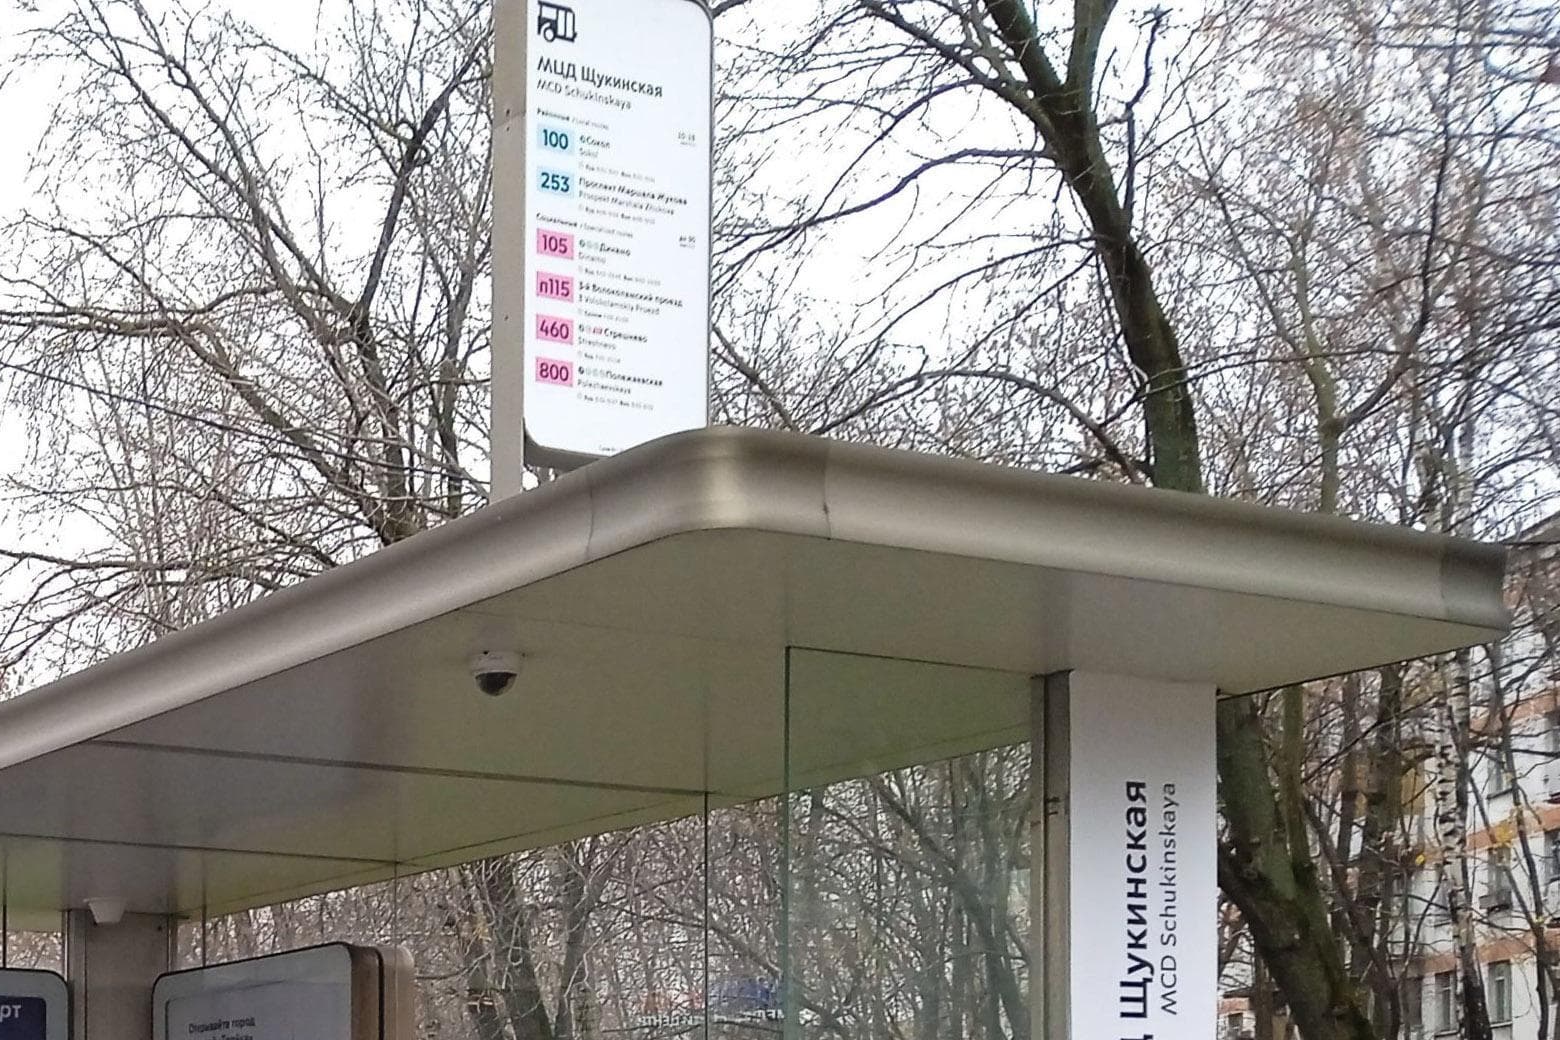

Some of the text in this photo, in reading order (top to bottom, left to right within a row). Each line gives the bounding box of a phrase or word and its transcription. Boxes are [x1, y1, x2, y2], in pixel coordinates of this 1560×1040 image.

[537, 56, 663, 98] МЦД Щукинская
[543, 129, 569, 150] 100
[541, 172, 570, 193] 253
[543, 234, 568, 255] 105
[540, 319, 569, 340] 460
[540, 362, 569, 382] 800
[1118, 780, 1156, 1019] Щукинская
[1158, 782, 1181, 1016] MCD Schukinskaya
